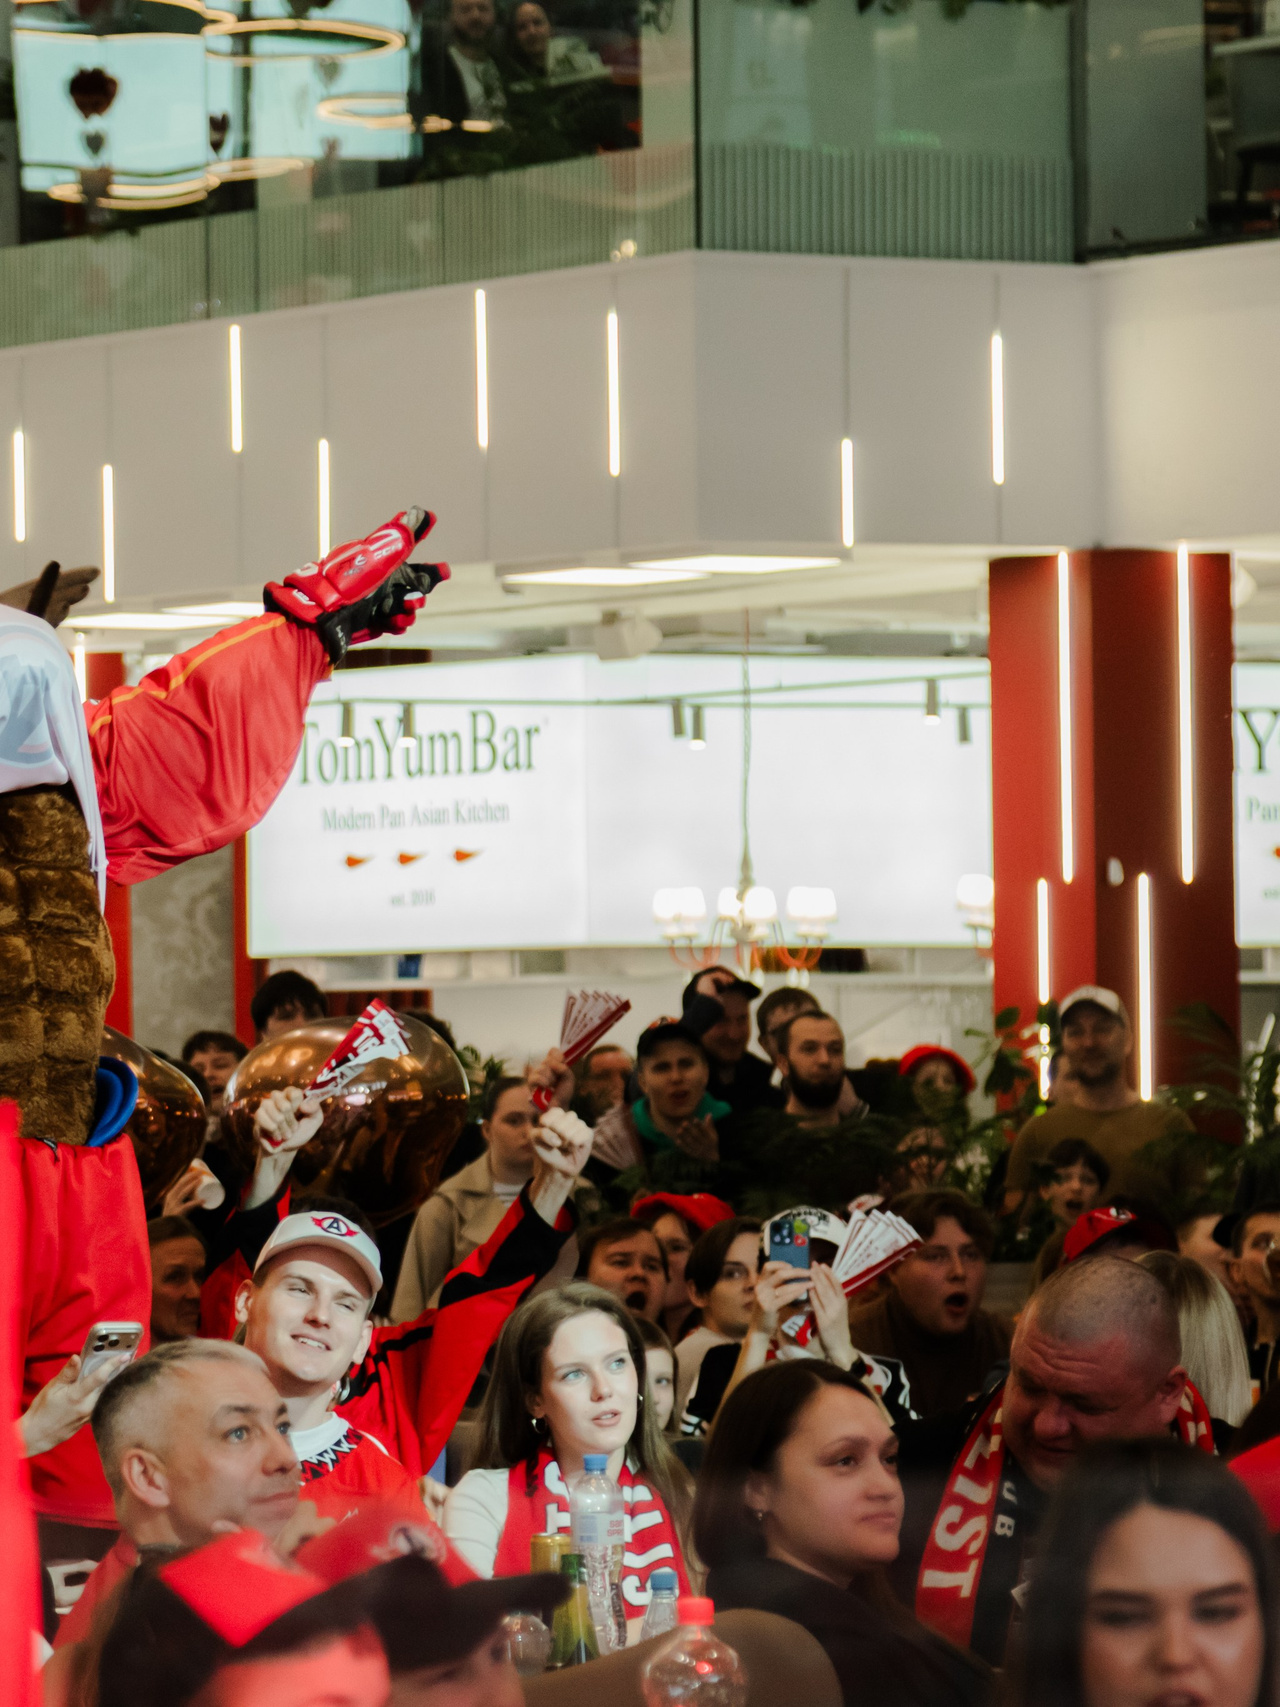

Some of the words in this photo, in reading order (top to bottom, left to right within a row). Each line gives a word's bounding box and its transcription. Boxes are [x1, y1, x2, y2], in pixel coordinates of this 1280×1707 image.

[298, 708, 541, 787] TomYumBar
[1238, 707, 1280, 773] Y
[322, 805, 376, 831] Modern
[380, 804, 406, 828] Pan
[410, 800, 450, 826] Asian
[454, 797, 511, 824] Kitchen
